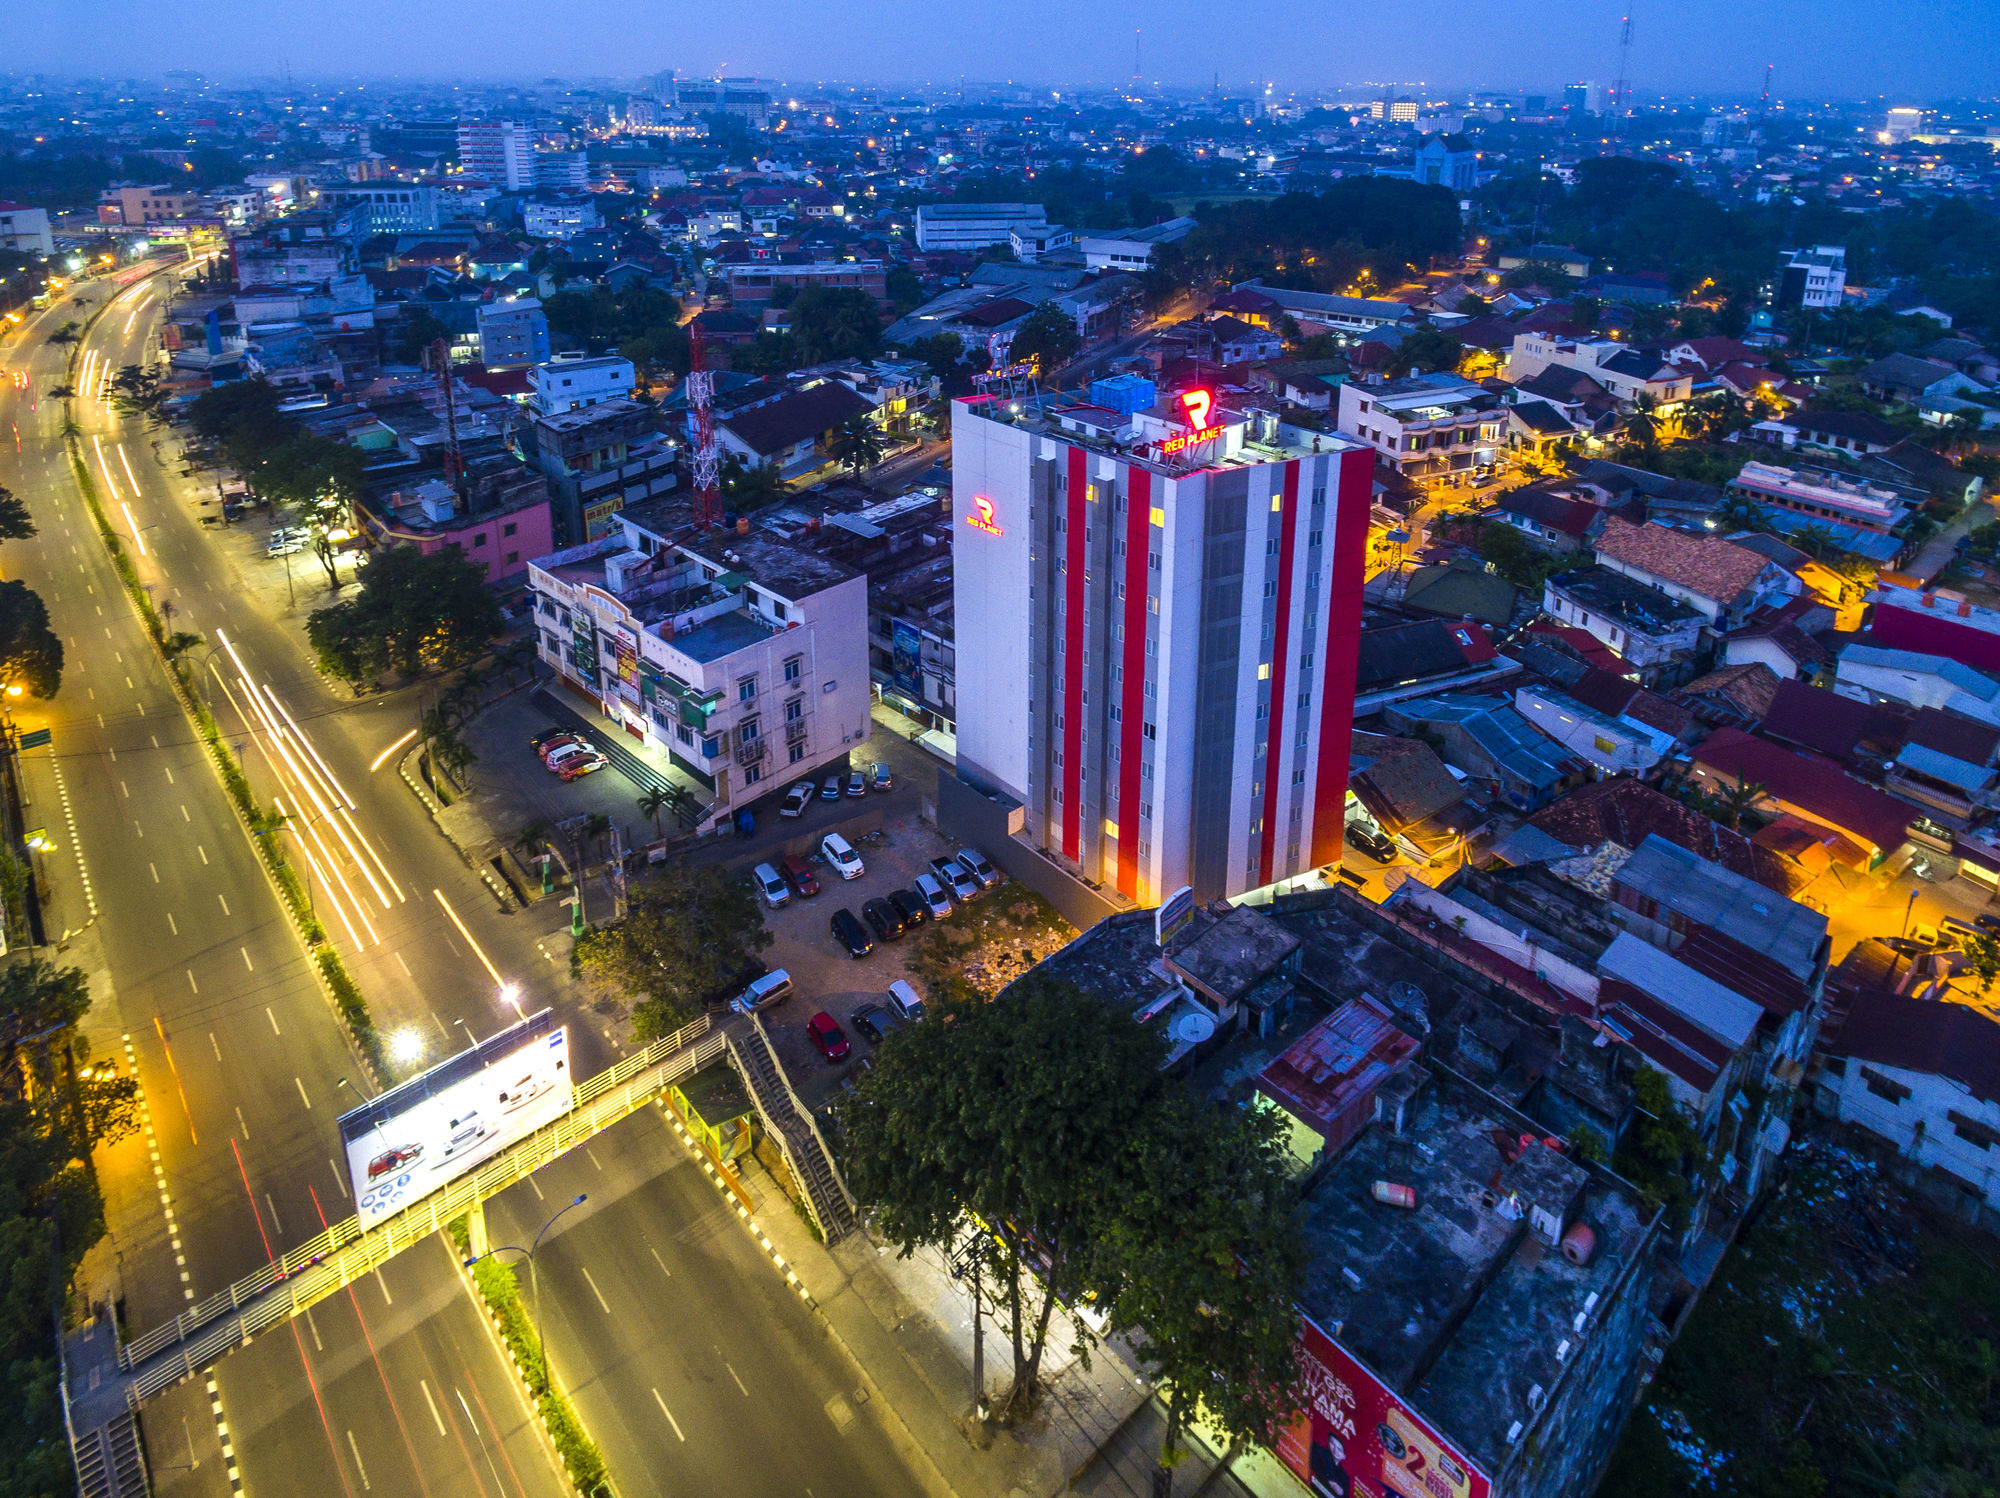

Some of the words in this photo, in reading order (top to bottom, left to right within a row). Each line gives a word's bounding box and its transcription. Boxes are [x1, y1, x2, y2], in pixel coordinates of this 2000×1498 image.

[1163, 437, 1185, 454] RED
[1187, 424, 1226, 447] PLANET
[587, 500, 622, 520] matrik
[966, 515, 979, 527] RED
[979, 521, 1003, 537] PLANET
[1323, 1375, 1356, 1409] GSC
[1406, 1445, 1426, 1482] 2
